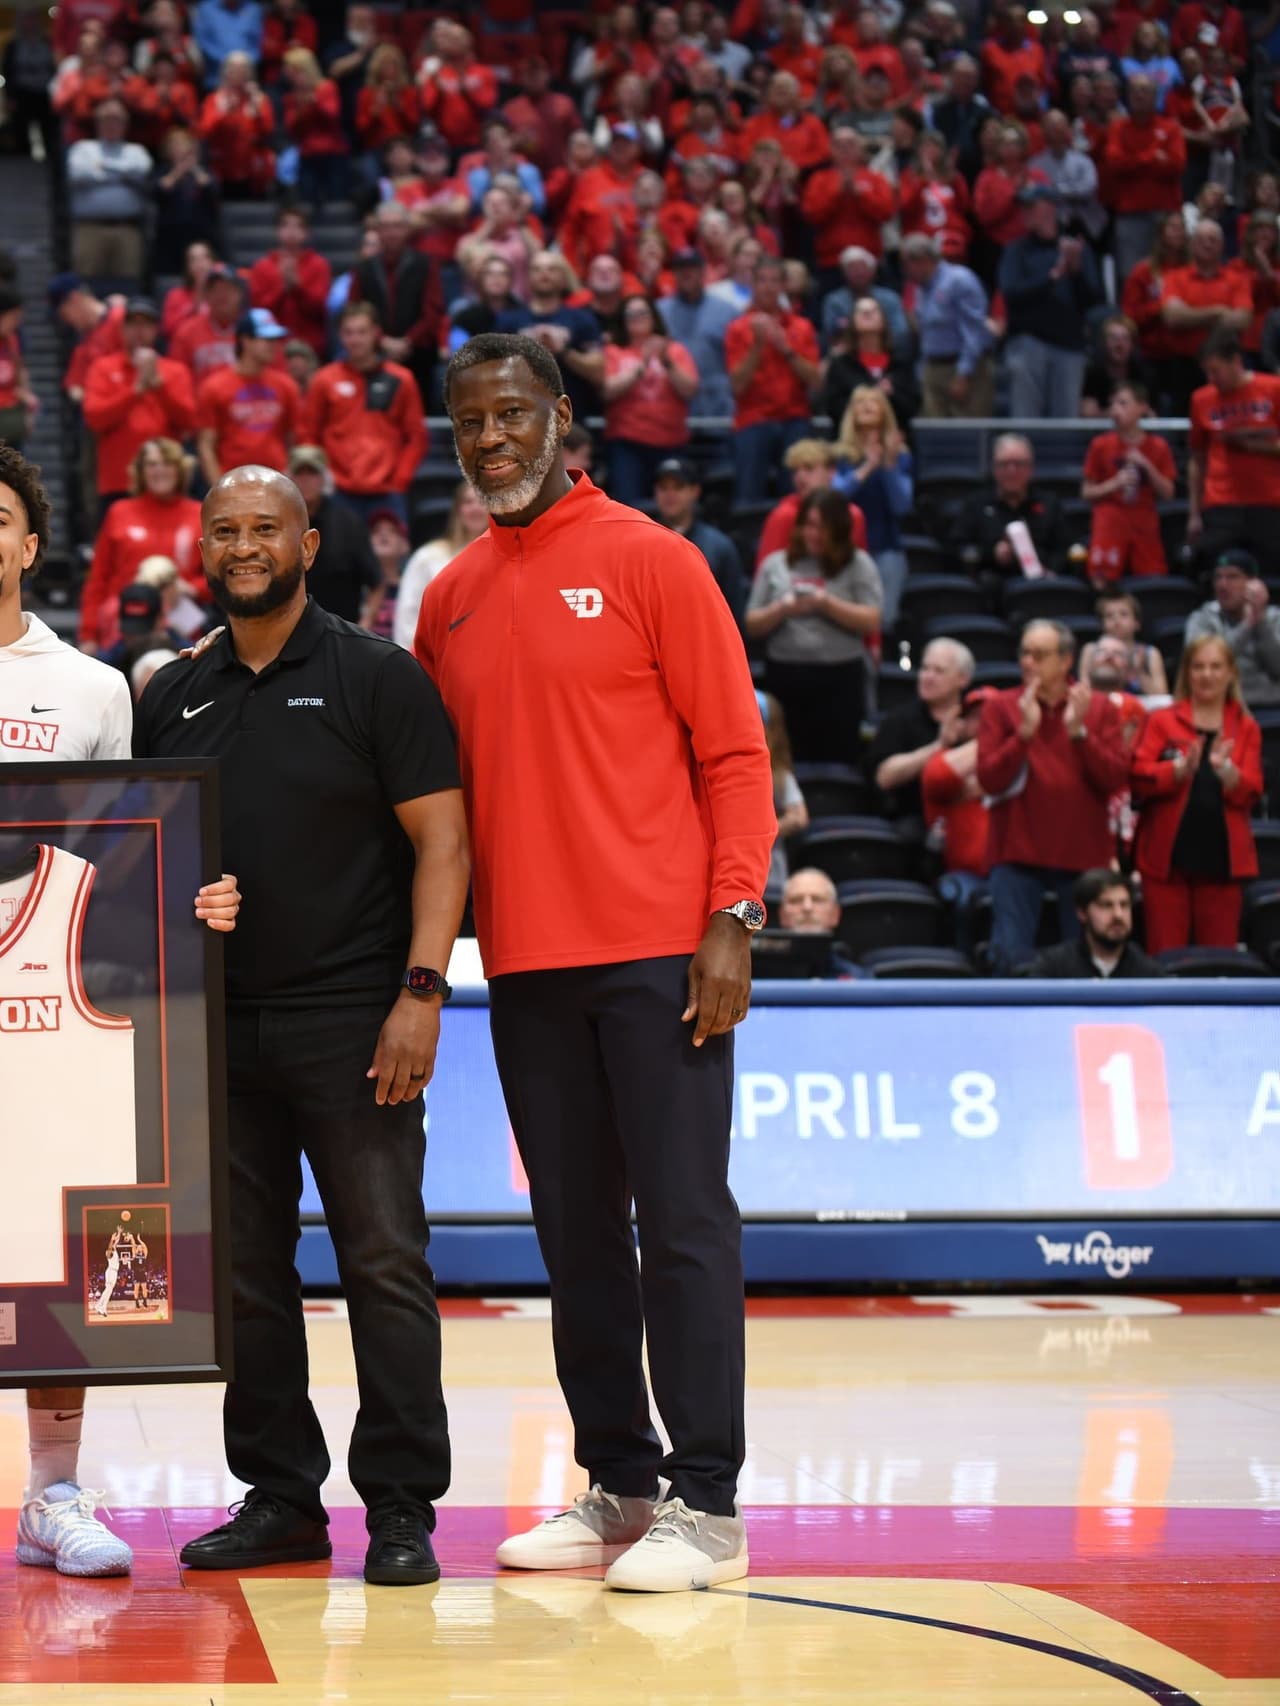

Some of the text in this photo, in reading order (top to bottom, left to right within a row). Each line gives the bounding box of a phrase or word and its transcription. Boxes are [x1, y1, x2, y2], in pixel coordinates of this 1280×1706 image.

[288, 697, 323, 707] DAYTON
[730, 1070, 1001, 1140] PRIL 8
[1098, 1051, 1140, 1161] 1
[1074, 1230, 1154, 1279] Kroger
